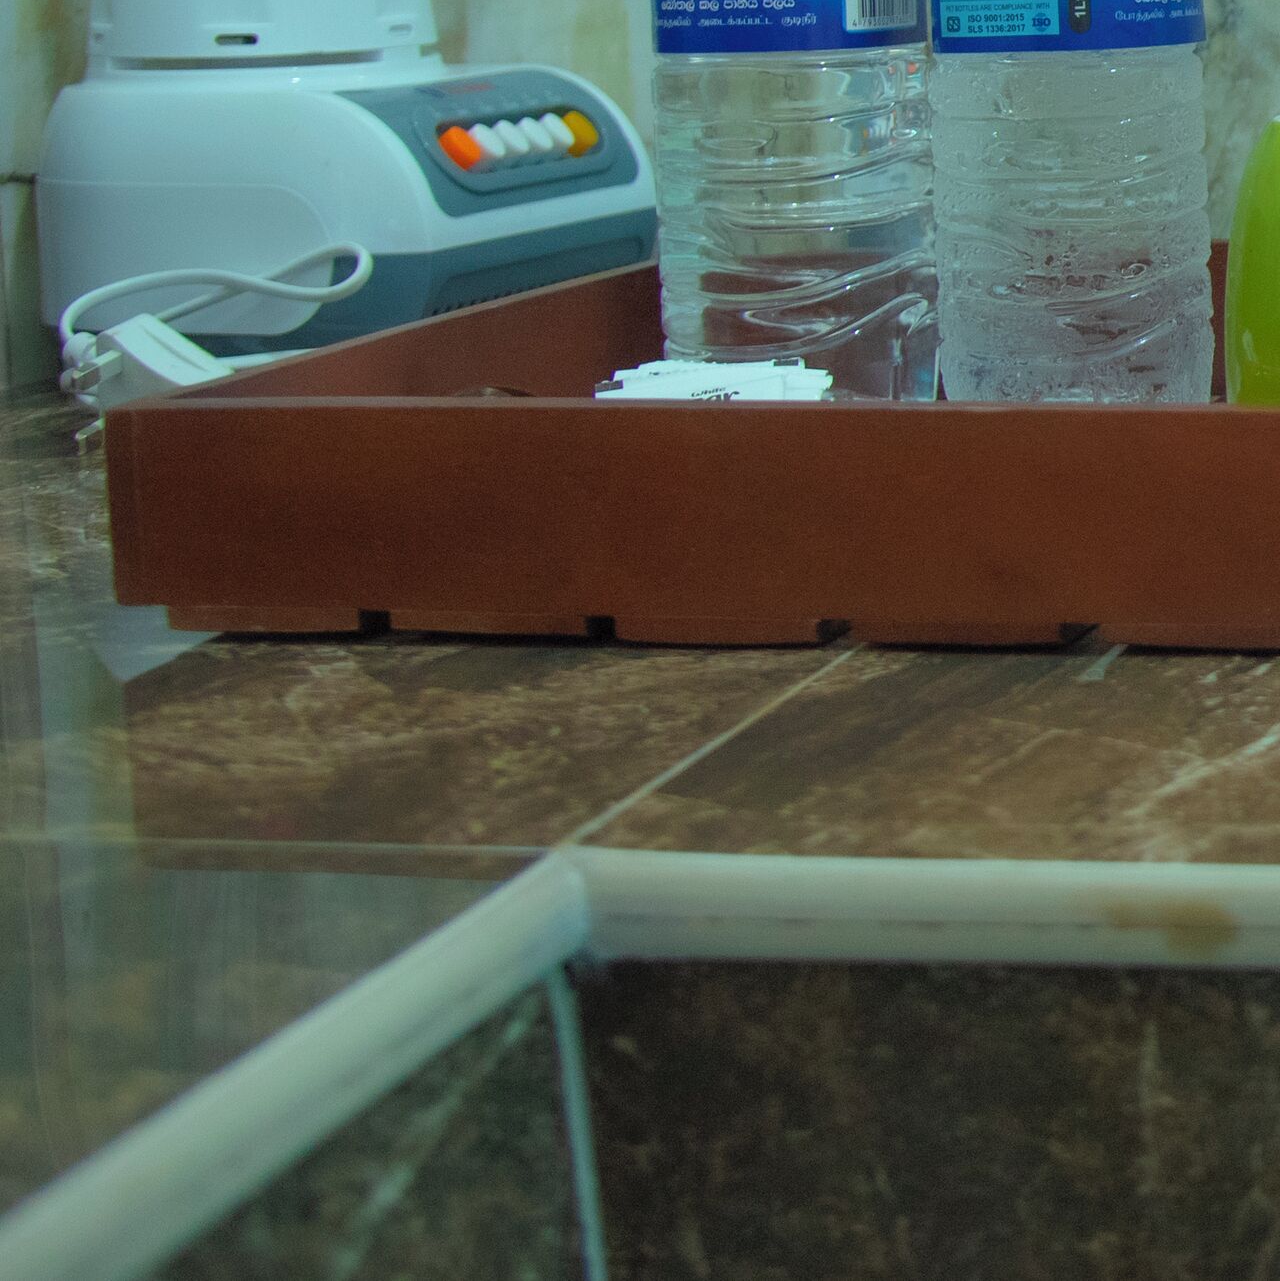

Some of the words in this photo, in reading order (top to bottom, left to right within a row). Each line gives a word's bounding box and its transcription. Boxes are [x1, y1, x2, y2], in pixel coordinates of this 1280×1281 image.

[993, 2, 1032, 12] COMPLIANCE
[967, 14, 982, 23] ISO
[983, 13, 1025, 23] 9001:2015
[1032, 18, 1051, 27] ISO
[967, 24, 983, 34] SLS
